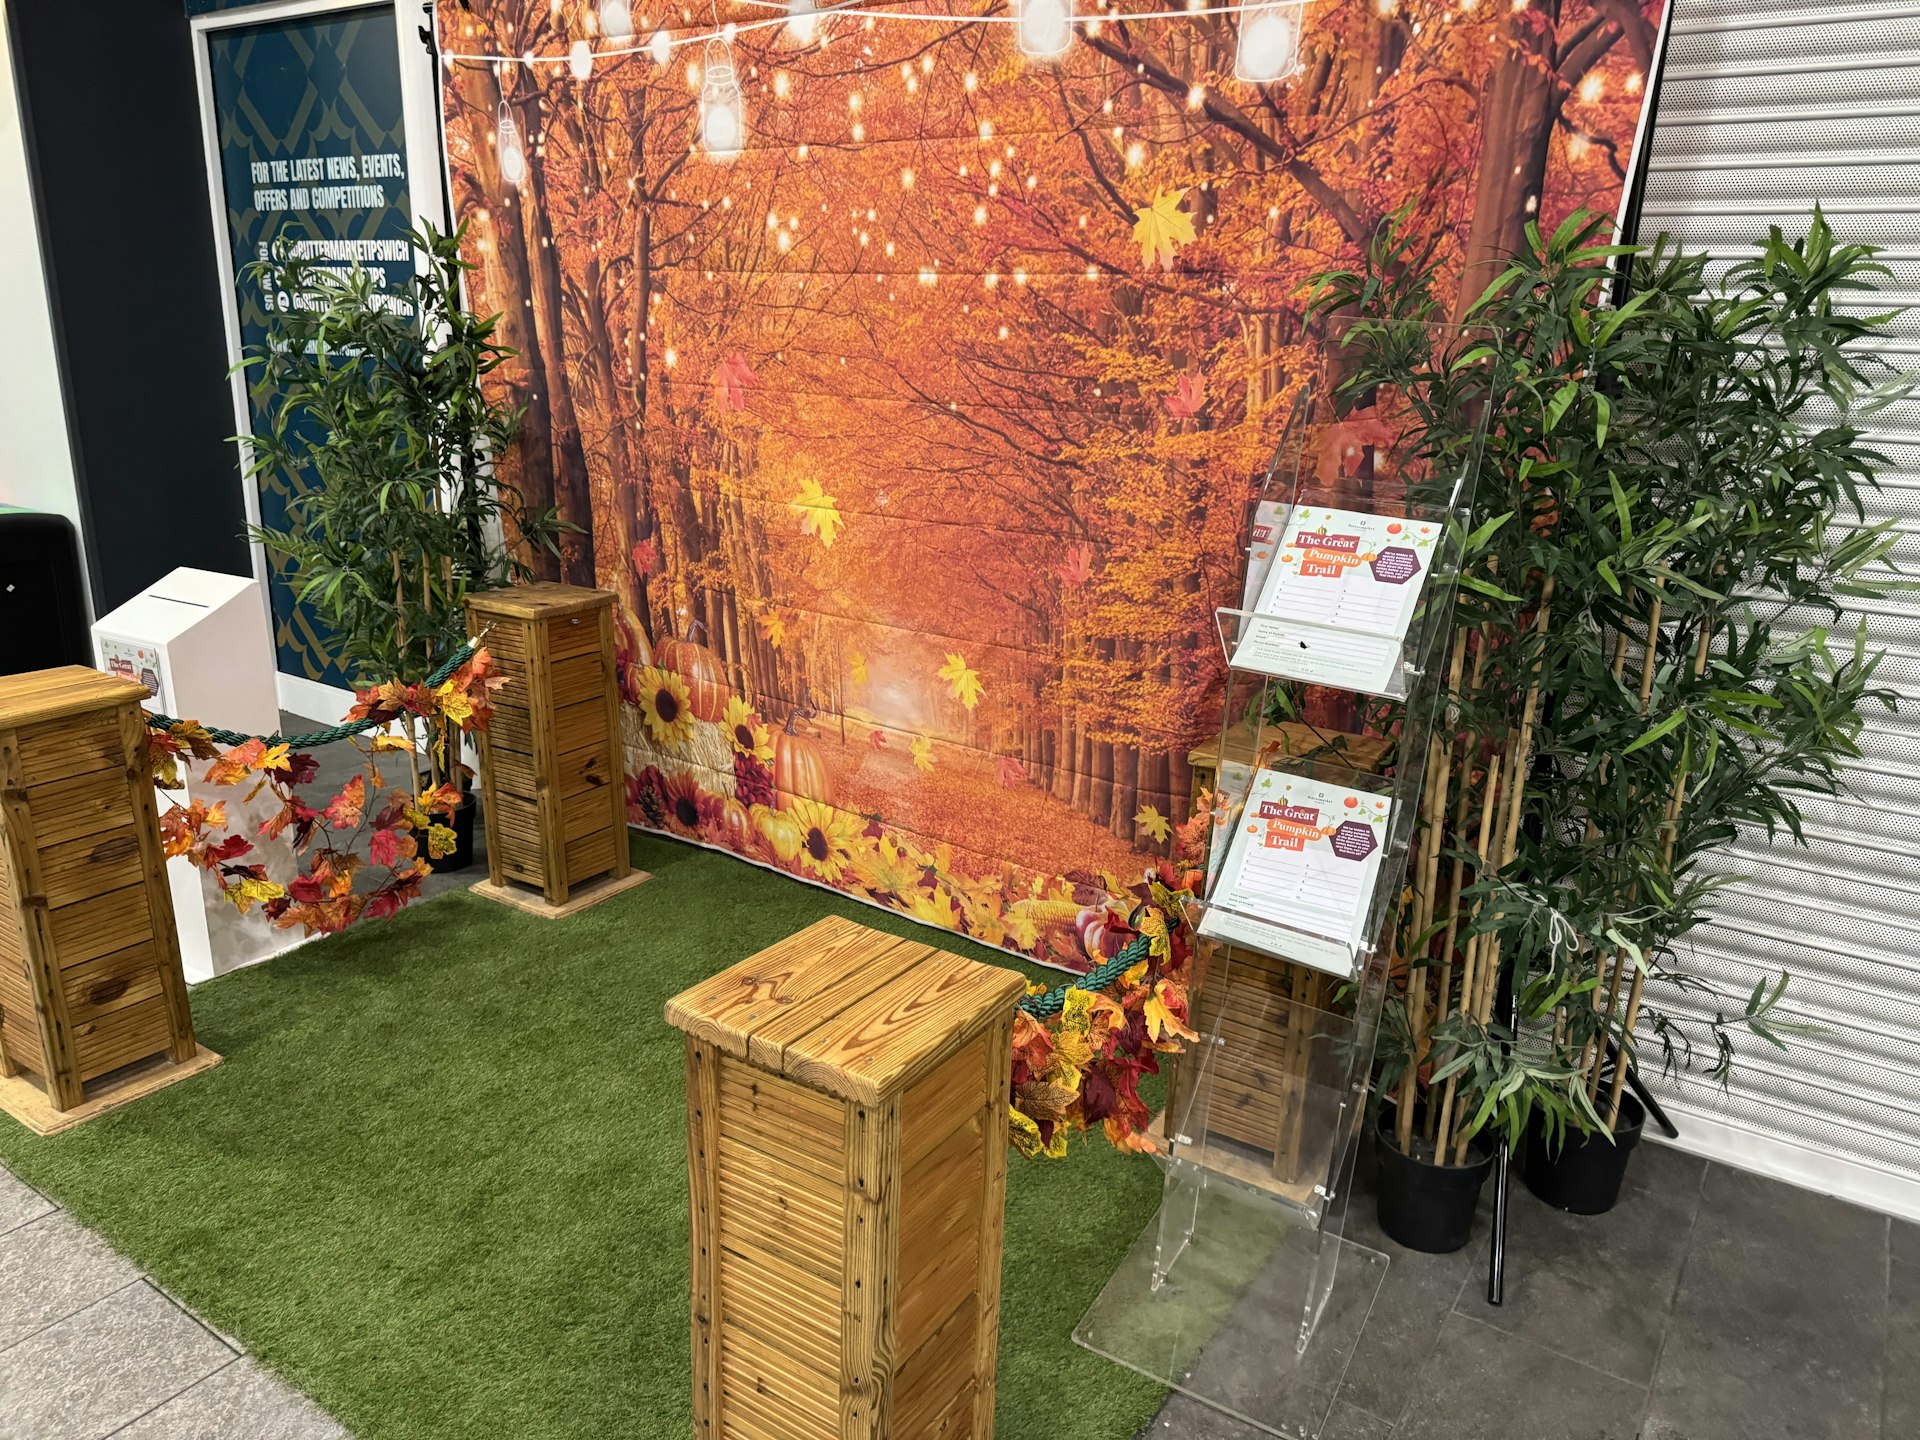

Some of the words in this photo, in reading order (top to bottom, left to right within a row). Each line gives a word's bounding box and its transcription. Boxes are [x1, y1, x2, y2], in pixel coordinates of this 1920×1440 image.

[251, 162, 270, 184] FOR
[270, 160, 289, 183] THE
[290, 158, 325, 182] LATEST
[326, 156, 360, 181] NEWS,
[361, 153, 405, 179] EVENTS,
[254, 189, 289, 212] OFFERS
[290, 187, 310, 210] AND
[311, 185, 385, 210] COMPETITIONS
[258, 241, 273, 290] FOLW
[264, 294, 275, 311] US
[1299, 534, 1321, 545] The
[1322, 536, 1356, 549] Great
[1309, 549, 1359, 565] Pumpkin
[1306, 563, 1336, 574] Trail
[1262, 804, 1283, 816] The
[1284, 808, 1316, 821] Great
[1272, 820, 1320, 839] Pumpkin
[1270, 835, 1299, 848] Trail
